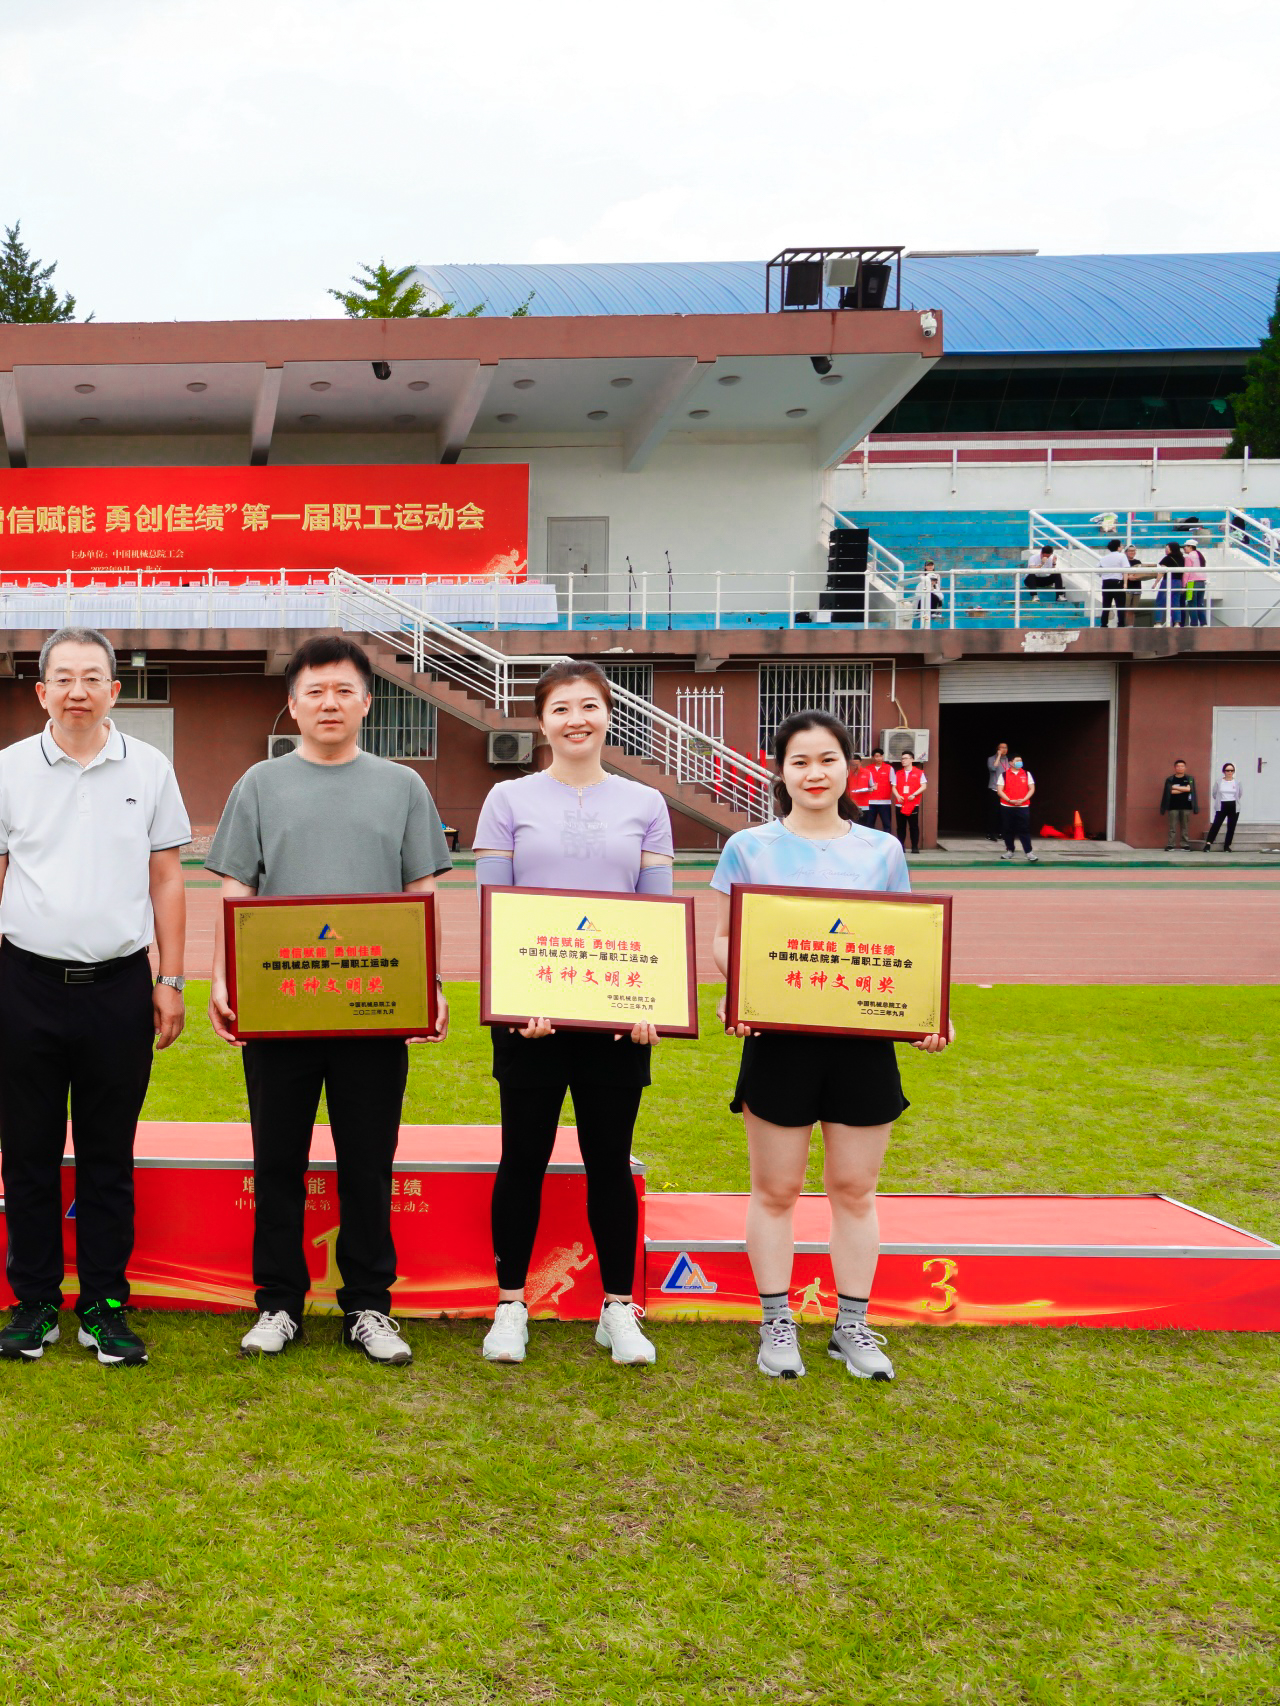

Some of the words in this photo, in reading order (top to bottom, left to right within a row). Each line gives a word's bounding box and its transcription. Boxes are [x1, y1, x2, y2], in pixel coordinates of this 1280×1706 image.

[105, 501, 486, 534] 勇创佳绩”第一届职工运动会
[279, 947, 327, 958] 增信赋能
[334, 945, 383, 957] 勇创佳绩
[536, 936, 585, 949] 增信赋能
[593, 939, 642, 951] 勇创佳绩
[787, 939, 837, 953] 增信赋能
[845, 942, 896, 956] 勇创佳绩
[262, 958, 400, 971] 中国机械总院第一届职工运动会
[519, 947, 659, 964] 中国机械总院第一届职工运动会
[769, 951, 913, 969] 中国机械总院第一届职工运动会
[536, 966, 644, 988] 精神文明奖
[785, 970, 896, 994] 精神文明奖
[279, 976, 384, 997] 精神文明奖
[921, 1257, 959, 1313] 3
